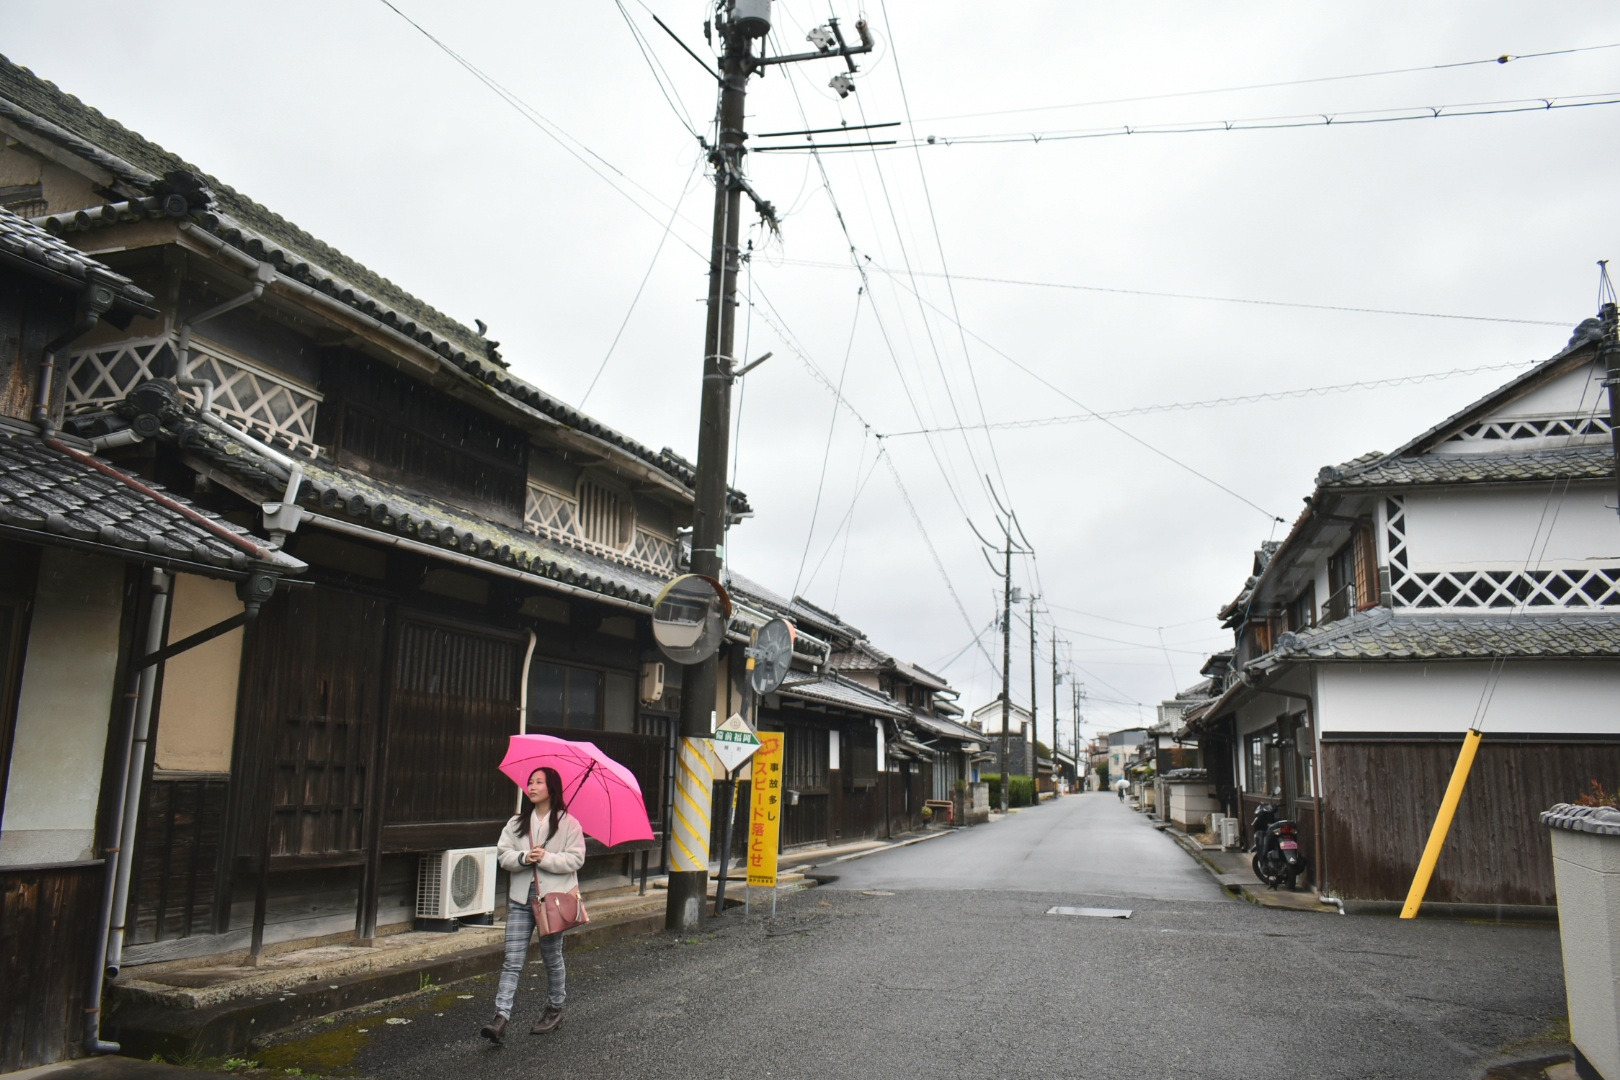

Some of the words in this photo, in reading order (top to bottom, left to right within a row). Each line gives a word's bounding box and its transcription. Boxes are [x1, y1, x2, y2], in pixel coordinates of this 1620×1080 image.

[716, 731, 752, 743] 備前福岡
[750, 762, 767, 867] スピード落とせ
[768, 763, 779, 821] 事故多し
